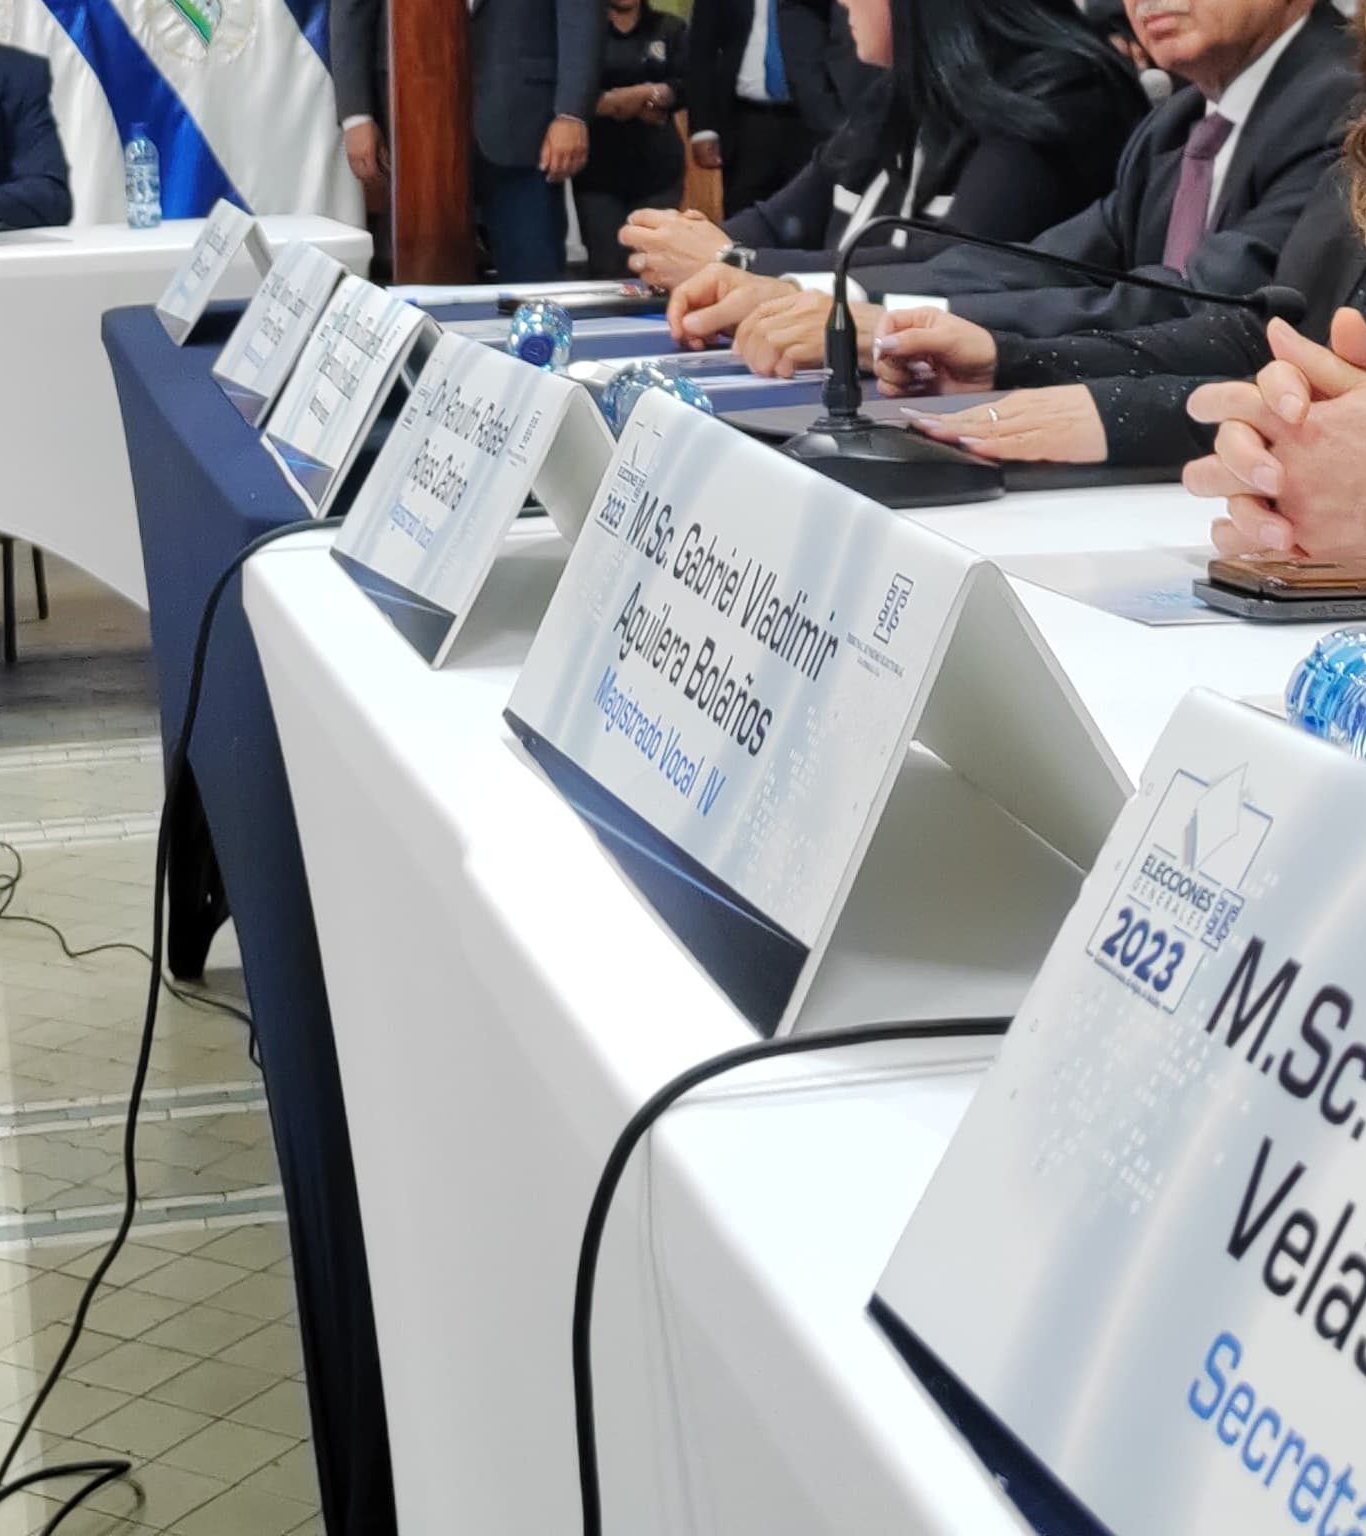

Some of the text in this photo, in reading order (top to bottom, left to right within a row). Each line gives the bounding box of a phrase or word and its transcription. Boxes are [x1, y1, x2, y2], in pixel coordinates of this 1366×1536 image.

[626, 490, 675, 569] M.Sc.
[673, 522, 753, 618] Gabriel
[740, 564, 840, 682] Vladimir
[613, 581, 691, 687] Aguilera
[683, 635, 773, 757] Bolaños
[593, 665, 727, 817] Magistrado Vocal IV
[1130, 875, 1206, 932] GENERALES
[1140, 853, 1216, 913] ELECCIONES
[1100, 906, 1186, 992] 2023
